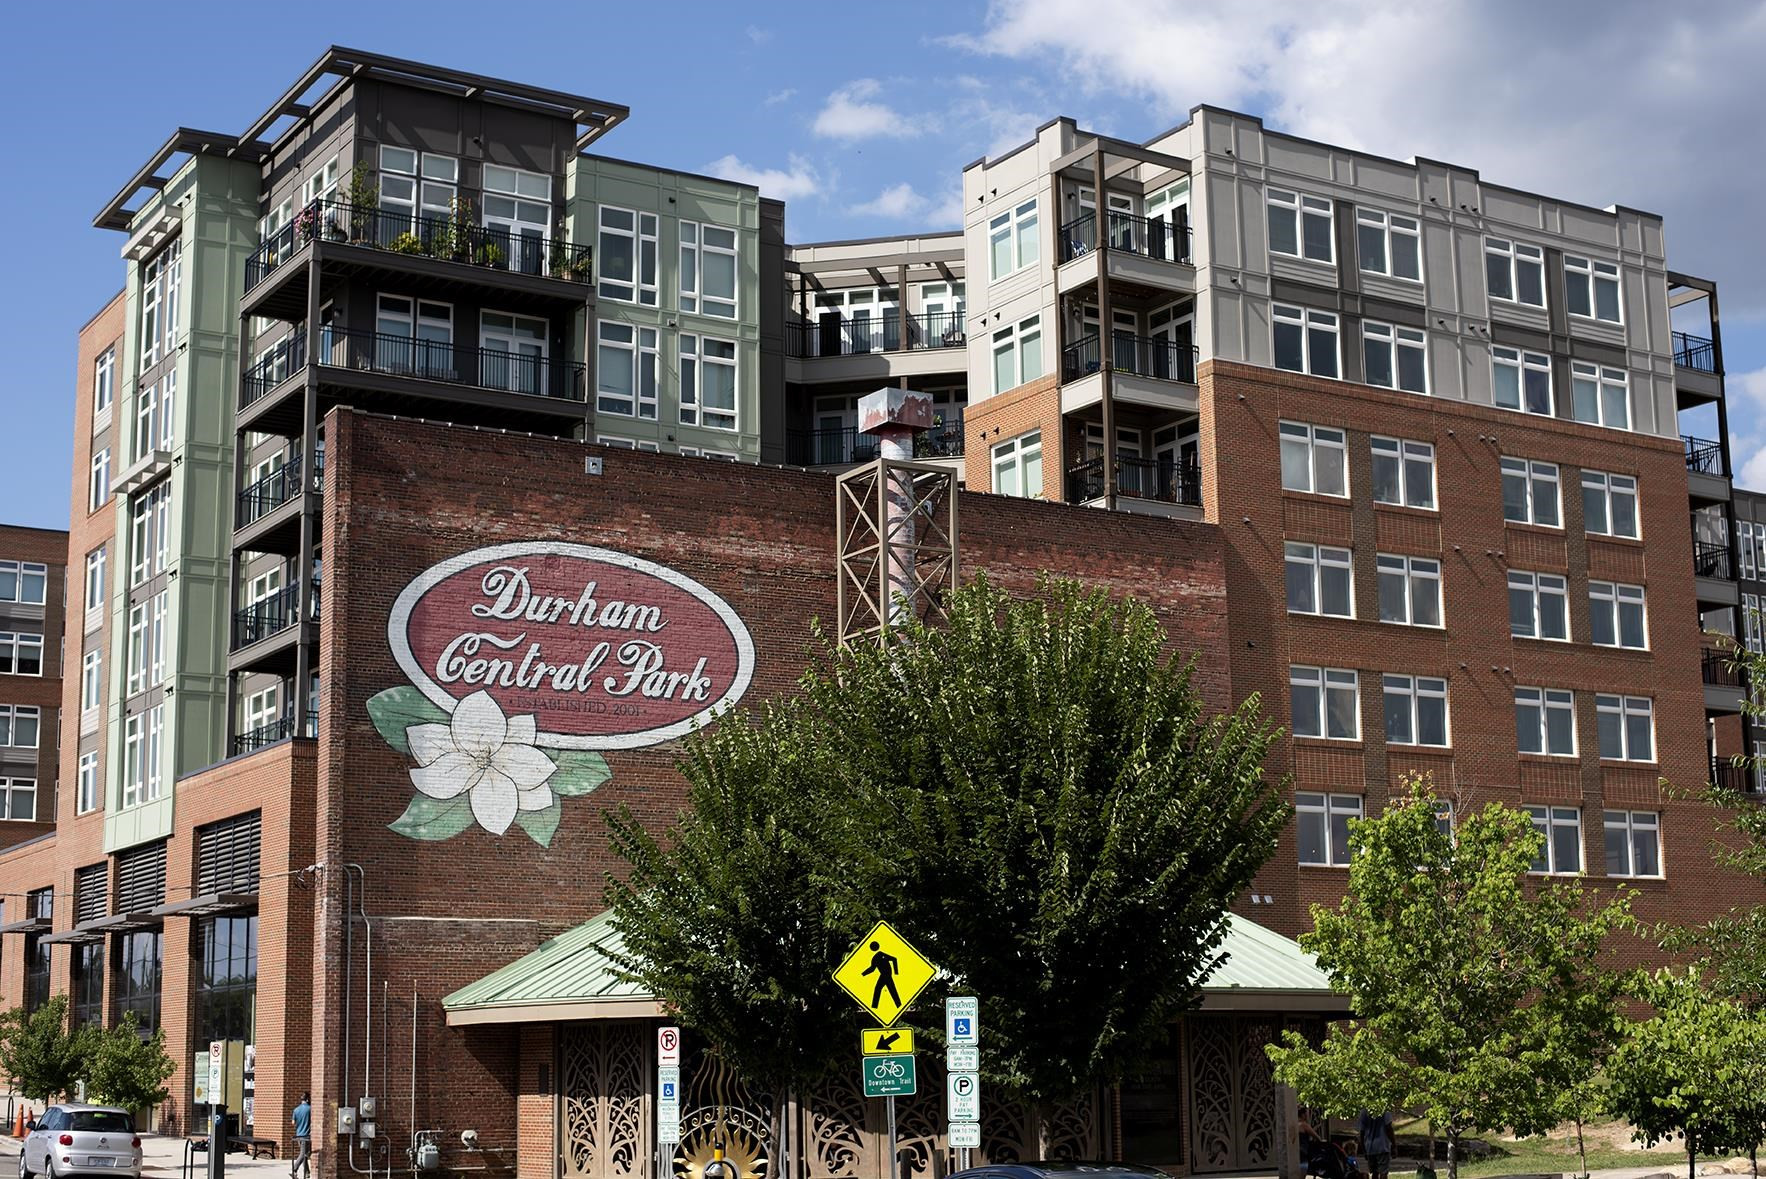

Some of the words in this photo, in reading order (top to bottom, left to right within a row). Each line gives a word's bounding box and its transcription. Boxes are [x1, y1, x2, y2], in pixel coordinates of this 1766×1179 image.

[471, 566, 669, 633] Durham
[436, 632, 610, 694] Central
[604, 639, 711, 702] Park
[516, 696, 607, 715] ESTABLISHED
[613, 703, 640, 717] 2001
[948, 1001, 976, 1009] RESERVED
[959, 1080, 969, 1093] P
